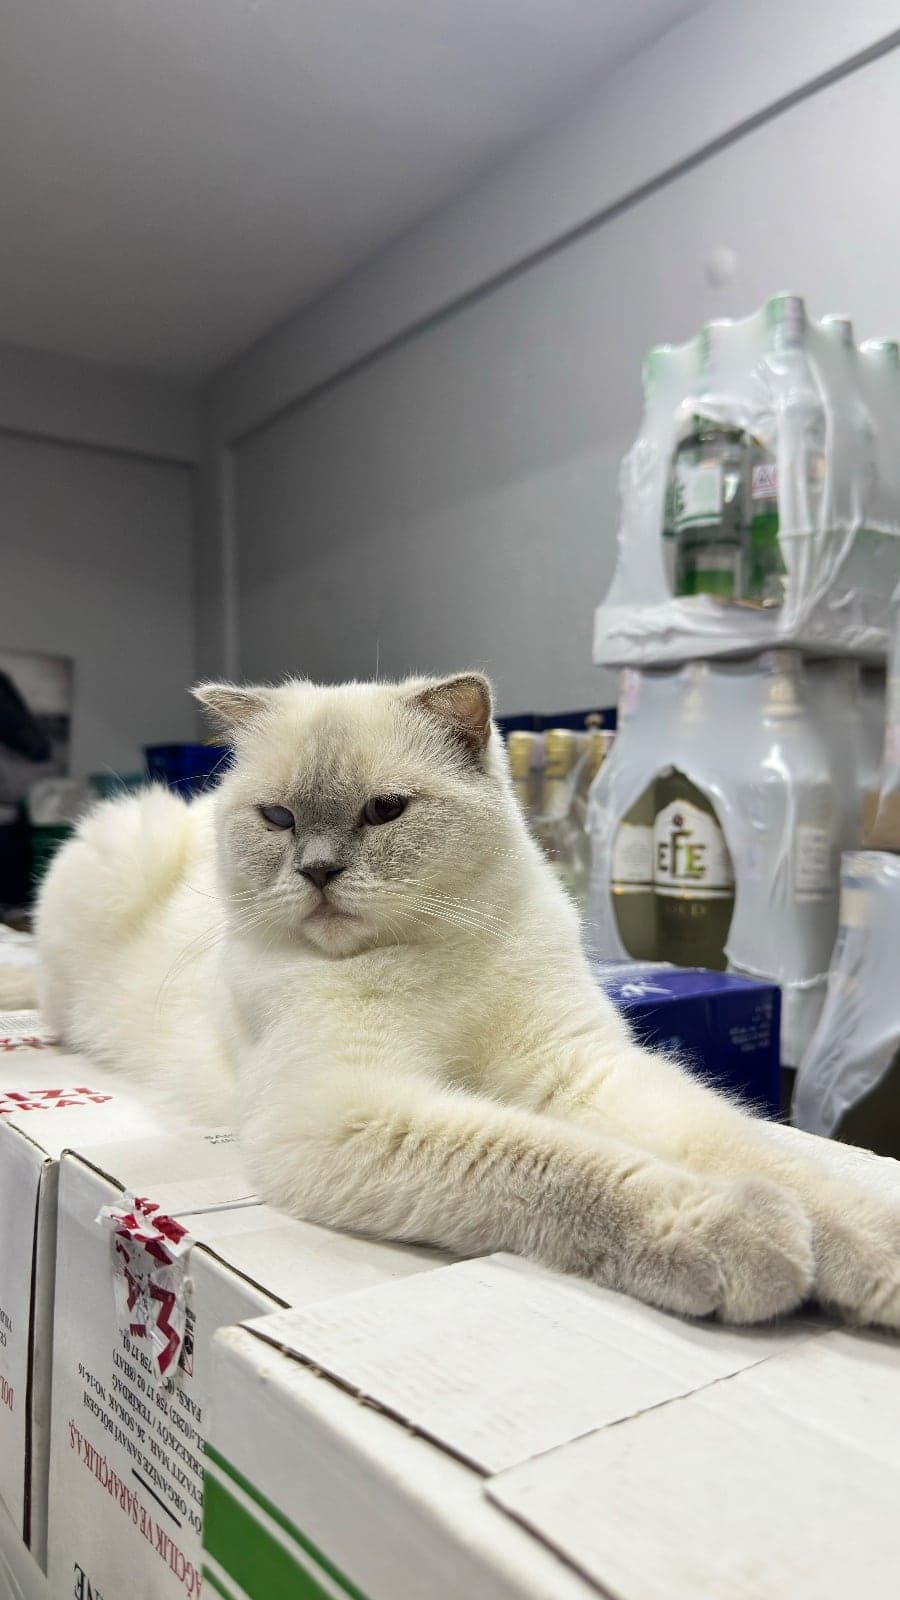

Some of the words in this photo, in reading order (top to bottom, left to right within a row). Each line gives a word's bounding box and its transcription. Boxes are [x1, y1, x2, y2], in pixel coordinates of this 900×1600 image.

[657, 831, 706, 879] EFE
[83, 1391, 114, 1434] BÖLGESİ
[112, 1374, 152, 1426] TEKİRDAĞ
[177, 1388, 202, 1424] FAKS:
[115, 1425, 142, 1465] SANAYİ
[143, 1457, 187, 1516] ORGANİZE
[139, 1506, 154, 1546] VE
